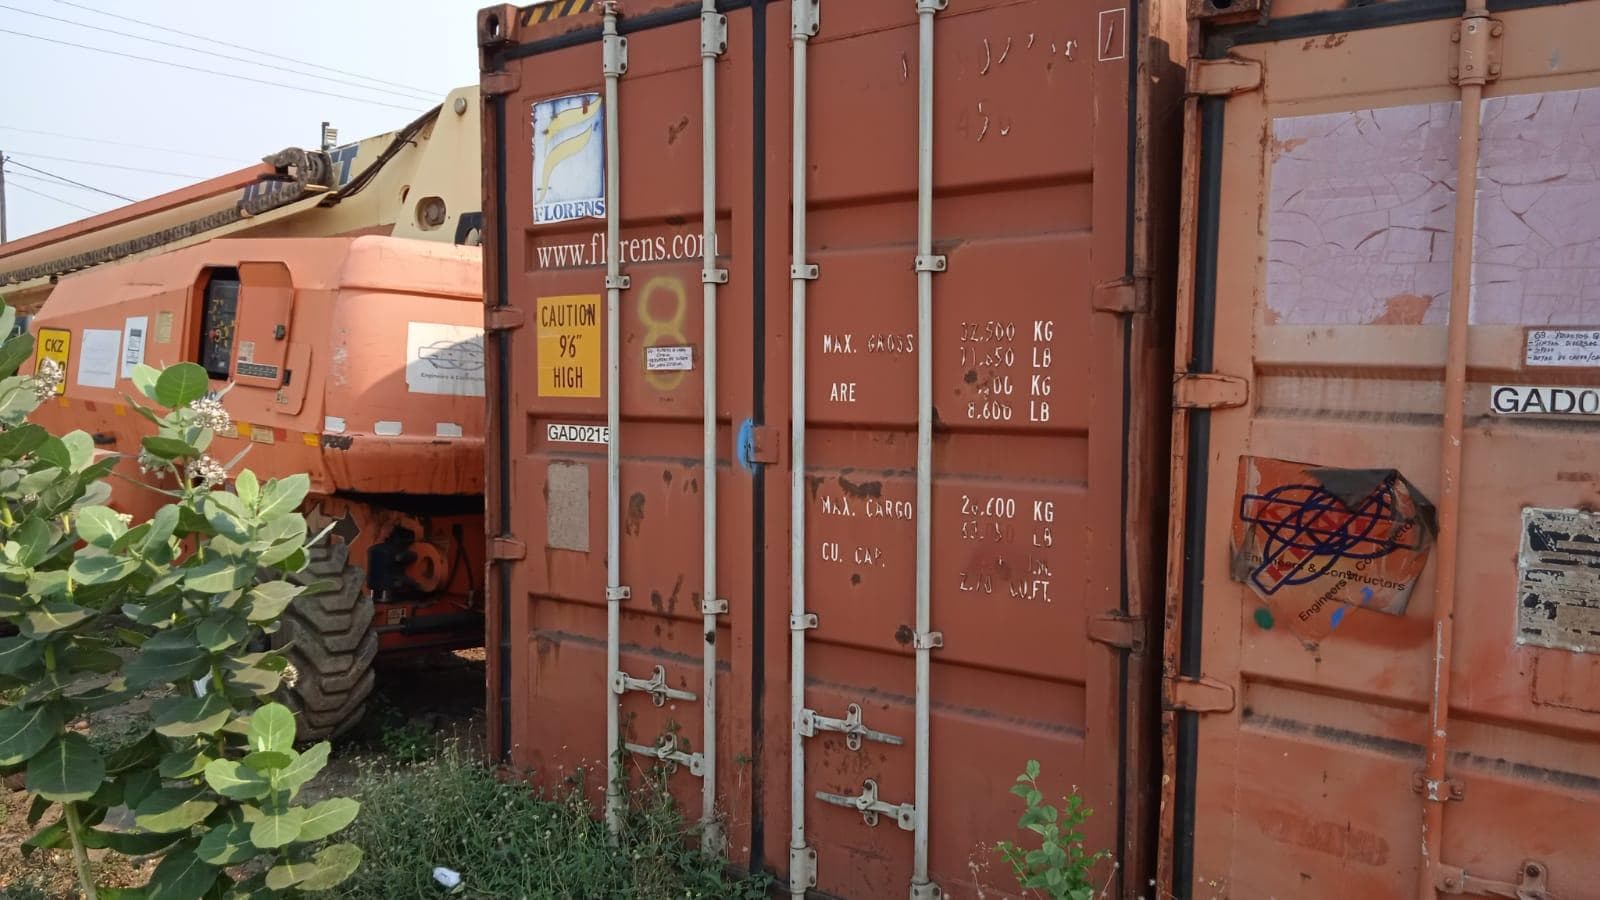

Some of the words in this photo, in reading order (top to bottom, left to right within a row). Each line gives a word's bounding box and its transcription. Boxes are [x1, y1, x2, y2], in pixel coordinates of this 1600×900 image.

[534, 200, 605, 222] FLORENS
[541, 303, 597, 327] CAUTION
[45, 338, 65, 353] CKZ
[823, 334, 857, 354] MAX.
[1033, 320, 1053, 341] KG
[1033, 347, 1051, 367] LB
[553, 366, 584, 389] HIGH
[1031, 374, 1051, 396] KG
[1030, 400, 1050, 422] LB
[1033, 500, 1054, 522] KG
[1298, 578, 1348, 622] Engineers
